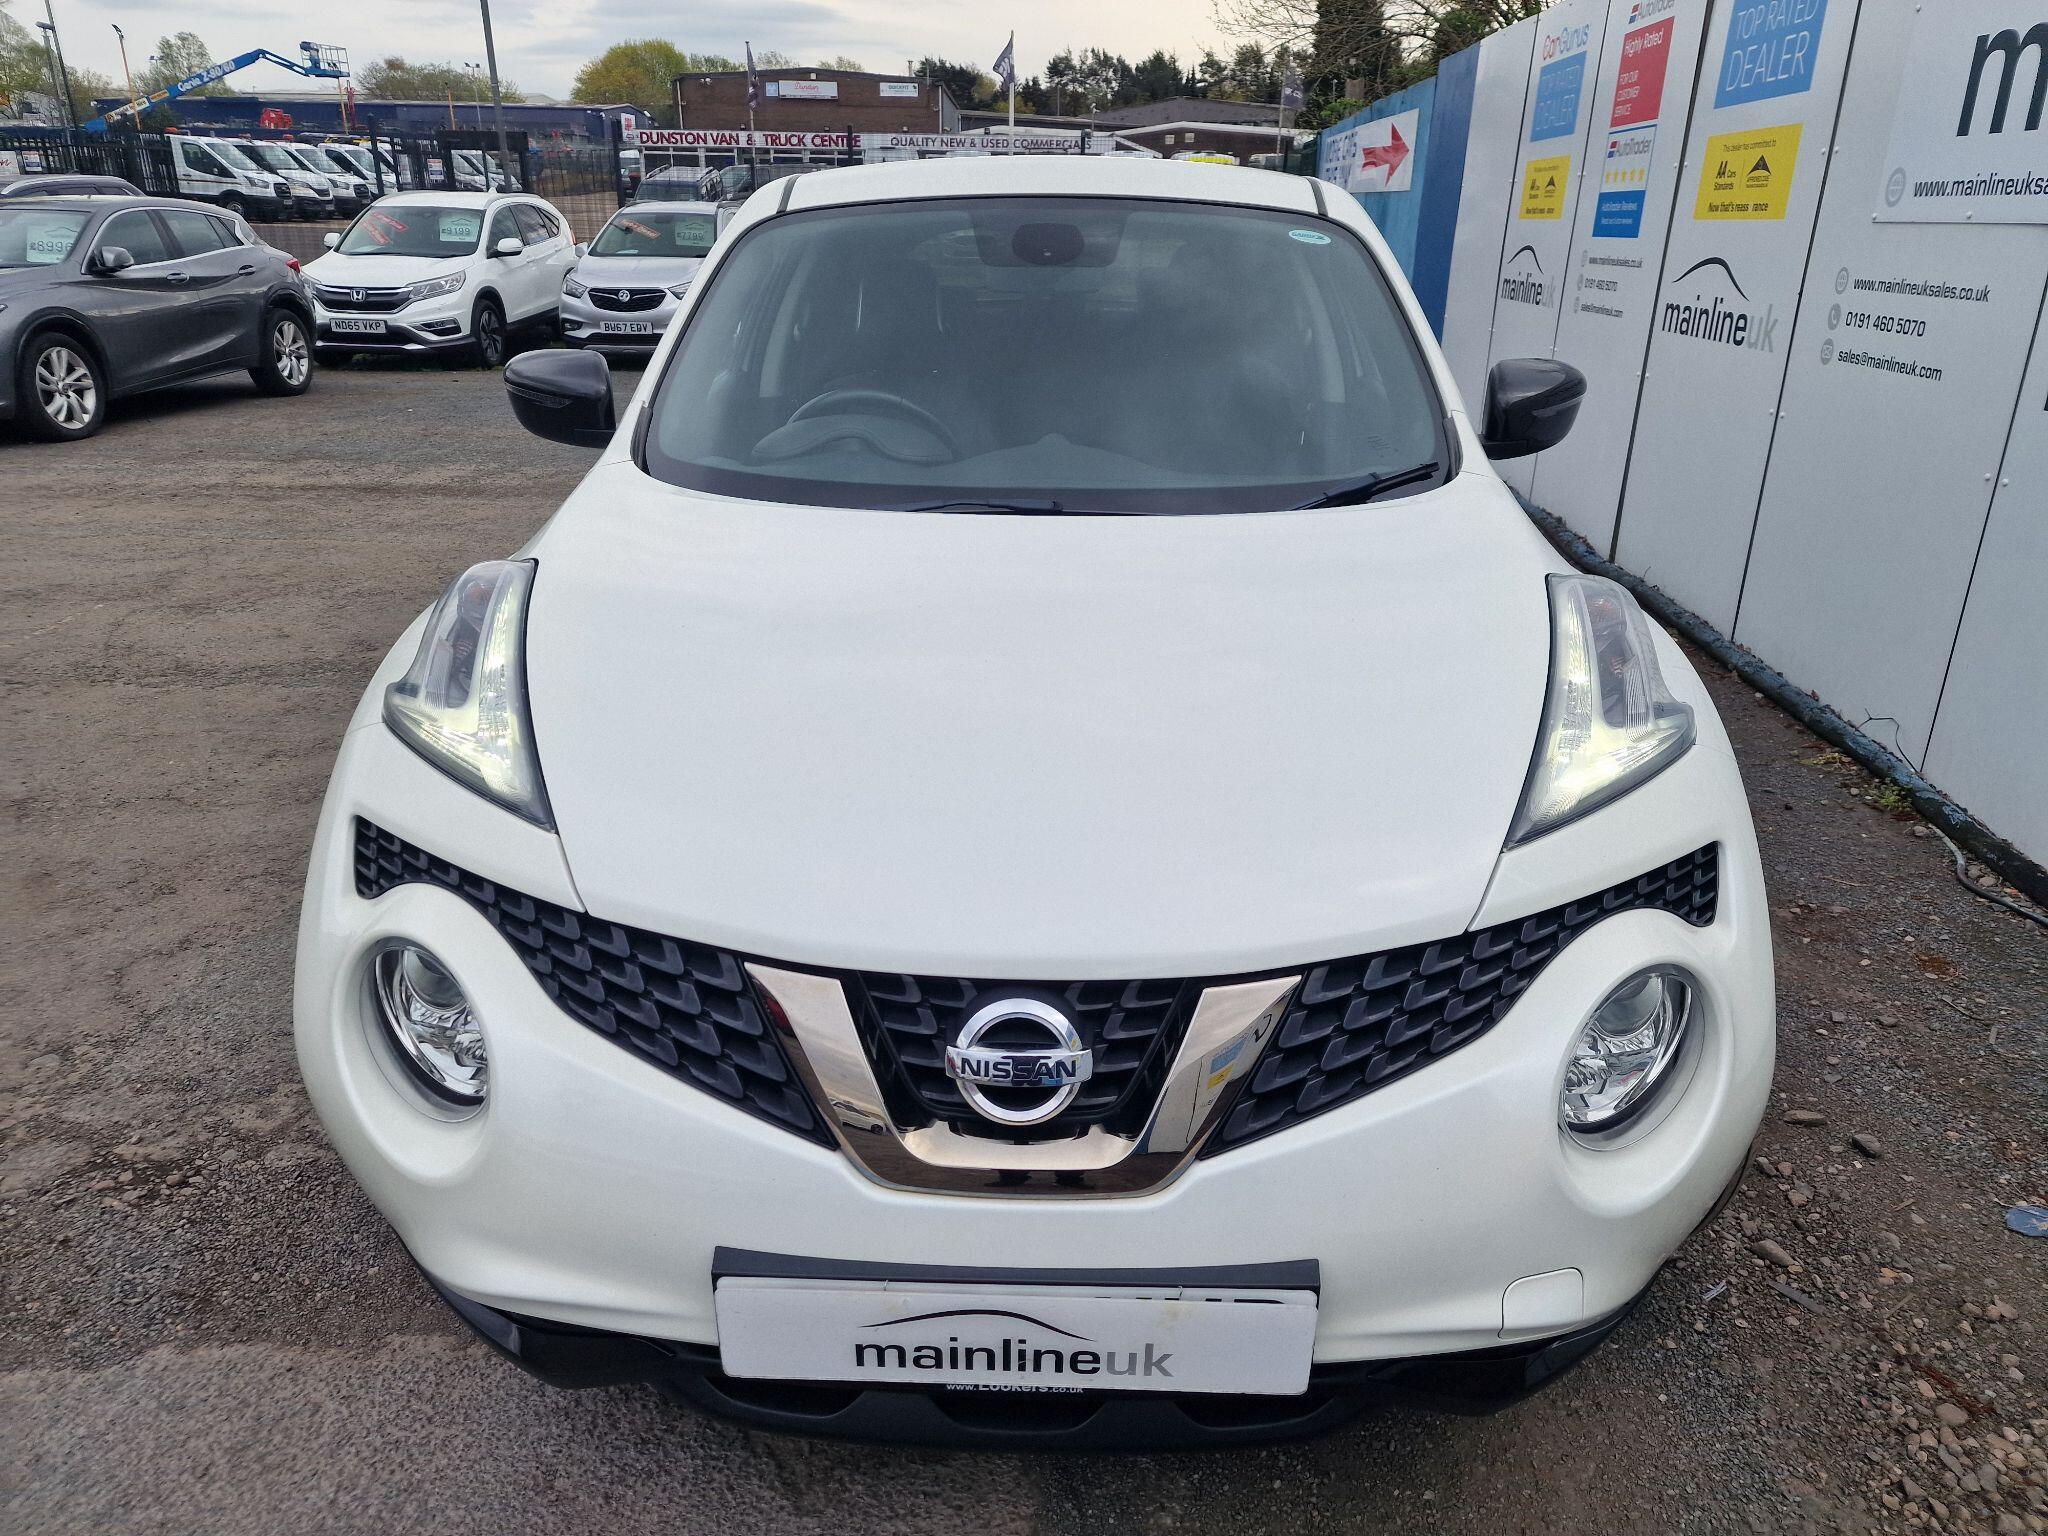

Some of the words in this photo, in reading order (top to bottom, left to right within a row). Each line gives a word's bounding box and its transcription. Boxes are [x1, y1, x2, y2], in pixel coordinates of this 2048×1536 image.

[1736, 5, 1766, 41] TOP
[1765, 0, 1820, 32] RATED
[1543, 24, 1590, 60] CarGurus
[1624, 37, 1643, 58] Highly
[1643, 28, 1664, 49] Rated
[1726, 31, 1810, 92] DEALER
[639, 131, 708, 145] DUNSTON
[710, 132, 740, 146] VAN
[746, 133, 756, 145] &
[763, 133, 806, 147] TRUCK
[890, 137, 937, 148] QUALITY
[940, 138, 967, 148] NEW
[970, 138, 977, 147] &
[981, 139, 1009, 149] USED
[1013, 139, 1092, 150] COMMERCIAS
[1616, 136, 1652, 157] AutoTrader
[1500, 271, 1557, 309] mainlineuk
[1853, 277, 1991, 302] www.mainlineuksales.co.uk
[334, 319, 361, 331] ND65
[362, 320, 382, 331] VKP
[604, 322, 627, 332] BU67
[1661, 294, 1779, 353] mainlineuk
[1845, 311, 1871, 329] 0191
[1872, 315, 1894, 333] 460
[1895, 318, 1926, 337] 5070
[1837, 349, 1943, 382] sales@mainlineuk.com
[961, 1057, 1077, 1080] NISSAN
[854, 1336, 1175, 1378] mainlineuk
